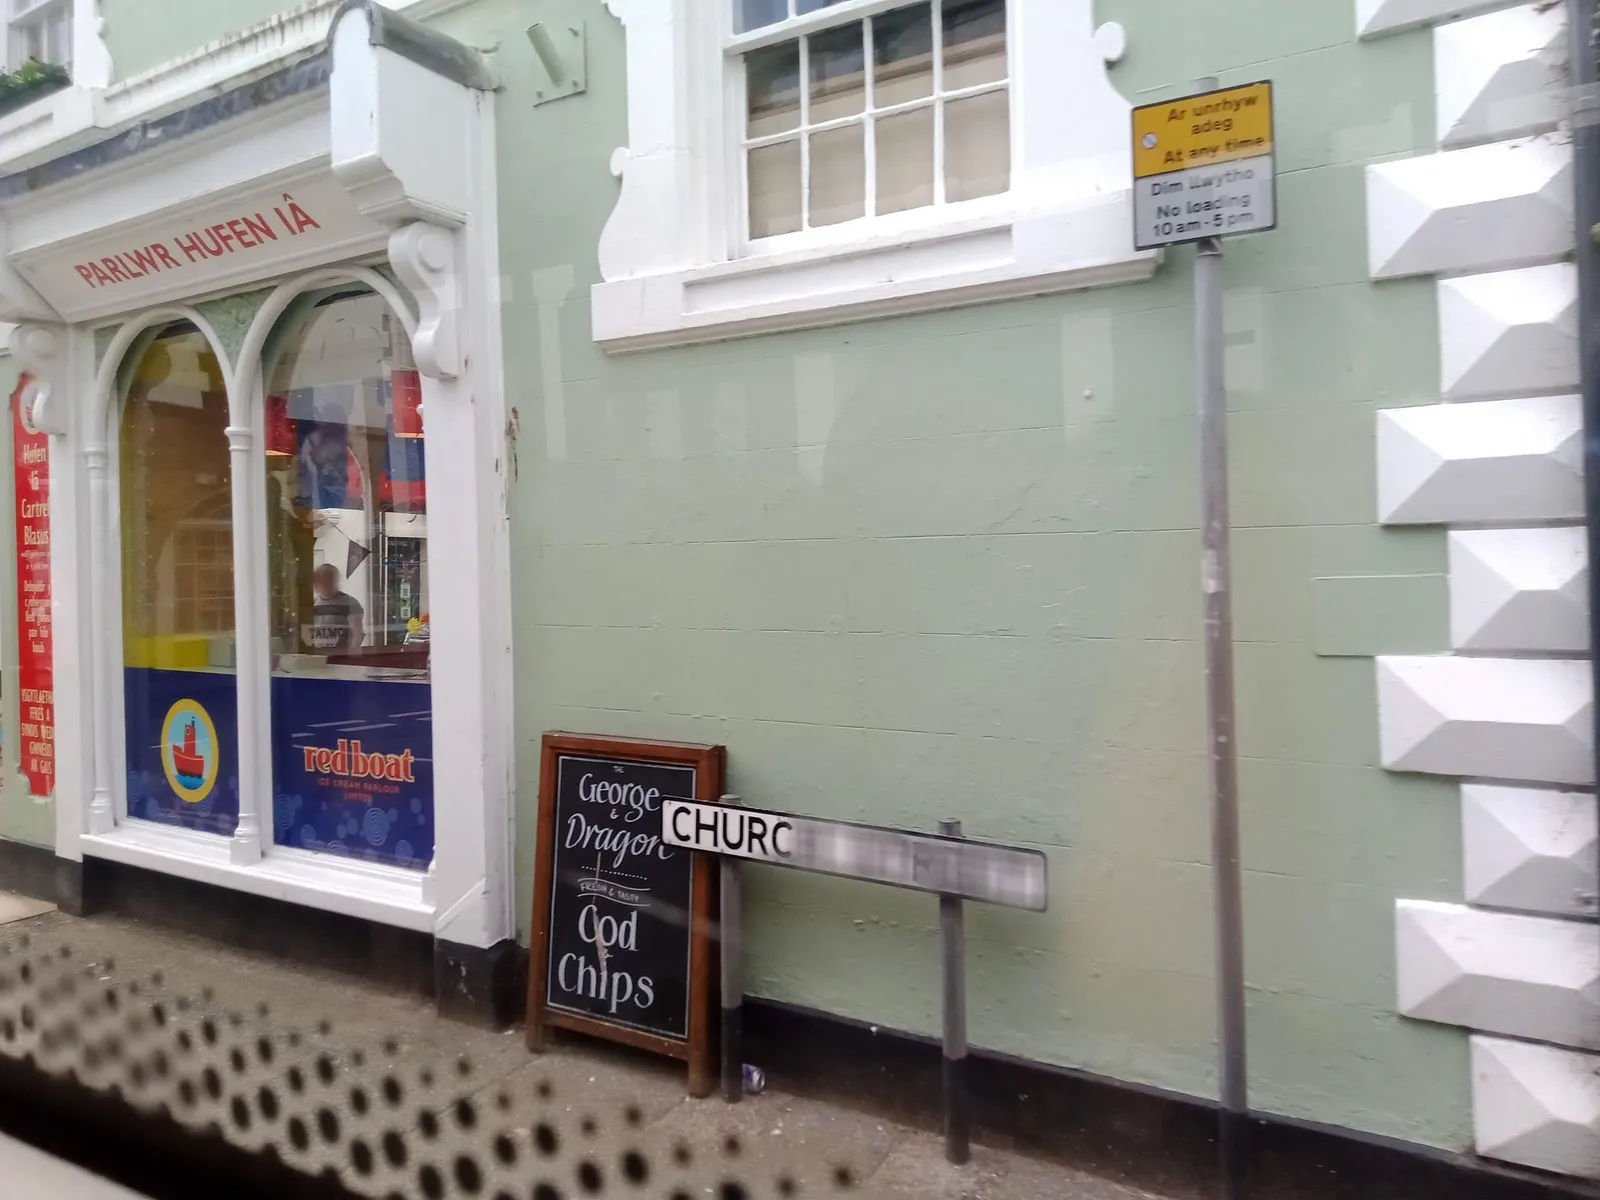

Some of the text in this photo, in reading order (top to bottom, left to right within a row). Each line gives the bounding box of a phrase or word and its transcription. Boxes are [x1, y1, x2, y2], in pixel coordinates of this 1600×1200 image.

[1167, 95, 1259, 122] Ar unrhyw
[1191, 117, 1233, 135] adeg
[1164, 136, 1264, 164] At any time
[1151, 181, 1183, 196] Dim
[1156, 193, 1250, 219] No loading
[74, 193, 321, 288] PARLWR HUFEN IÂ
[21, 499, 49, 518] Cartre
[333, 779, 361, 789] CREAM
[579, 773, 660, 823] George
[610, 809, 619, 819] &
[565, 813, 675, 868] Dragon
[672, 805, 795, 859] CHURC
[578, 904, 638, 951] Cod
[558, 952, 654, 1014] Chips
